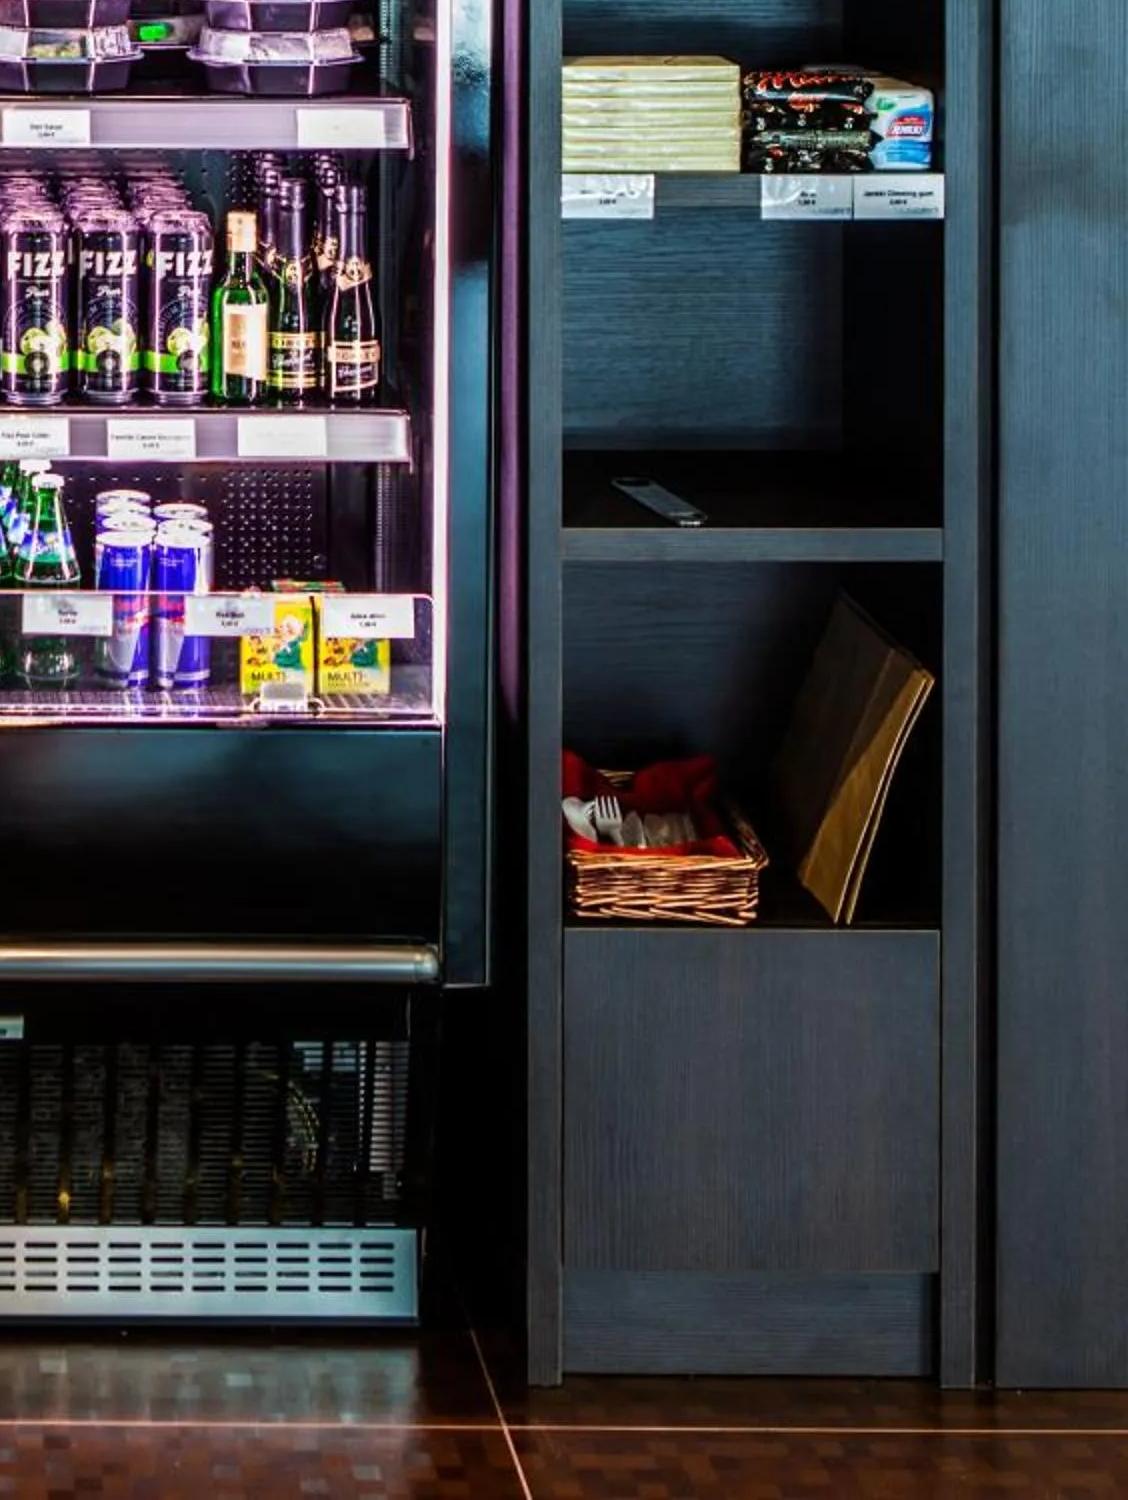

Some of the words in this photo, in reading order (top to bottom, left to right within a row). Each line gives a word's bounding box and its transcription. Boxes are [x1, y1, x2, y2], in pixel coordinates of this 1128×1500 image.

[7, 251, 65, 280] FIZZ
[79, 251, 137, 279] FIZZ
[156, 251, 214, 279] FIZZ
